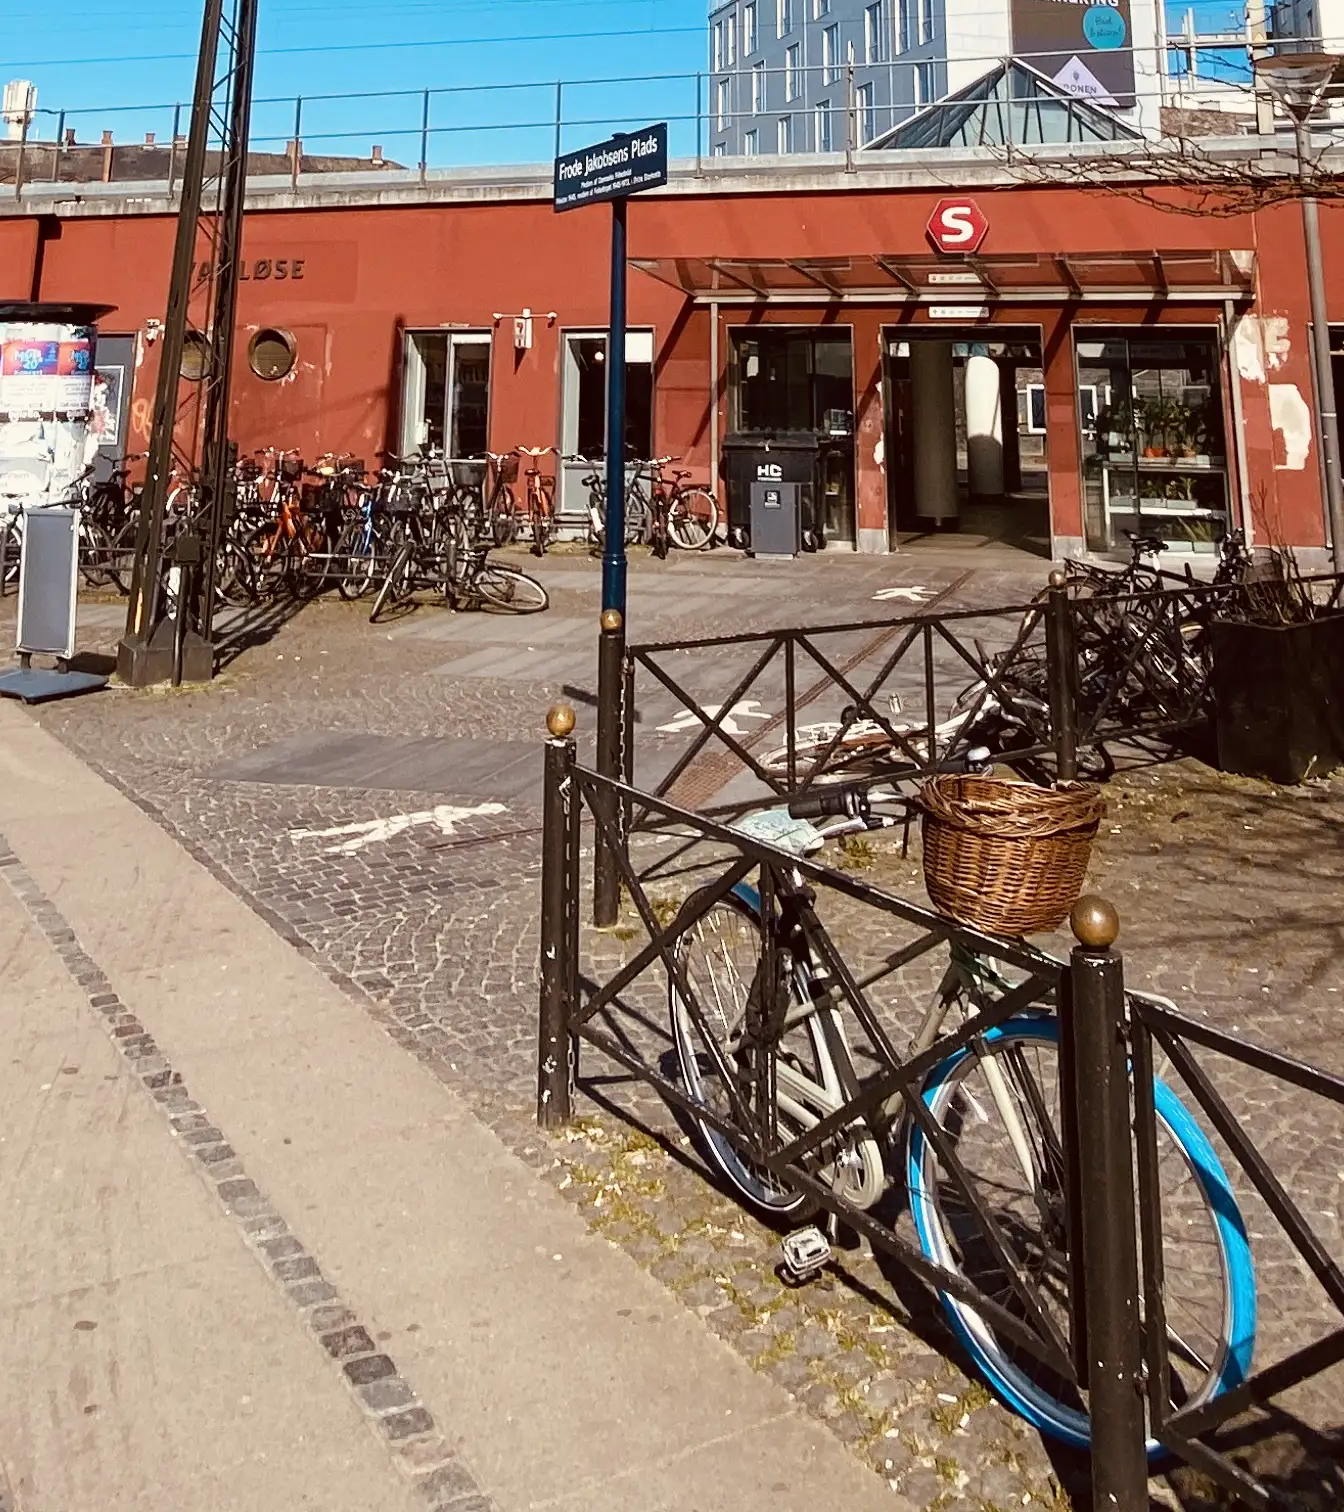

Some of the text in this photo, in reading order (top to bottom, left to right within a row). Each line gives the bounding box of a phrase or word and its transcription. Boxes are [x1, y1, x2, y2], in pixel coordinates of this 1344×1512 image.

[559, 159, 583, 181] Frode
[584, 147, 629, 177] Jakobsens
[631, 134, 658, 159] Plads
[941, 206, 974, 243] S
[188, 258, 305, 282] ALØSE
[757, 464, 782, 477] HC
